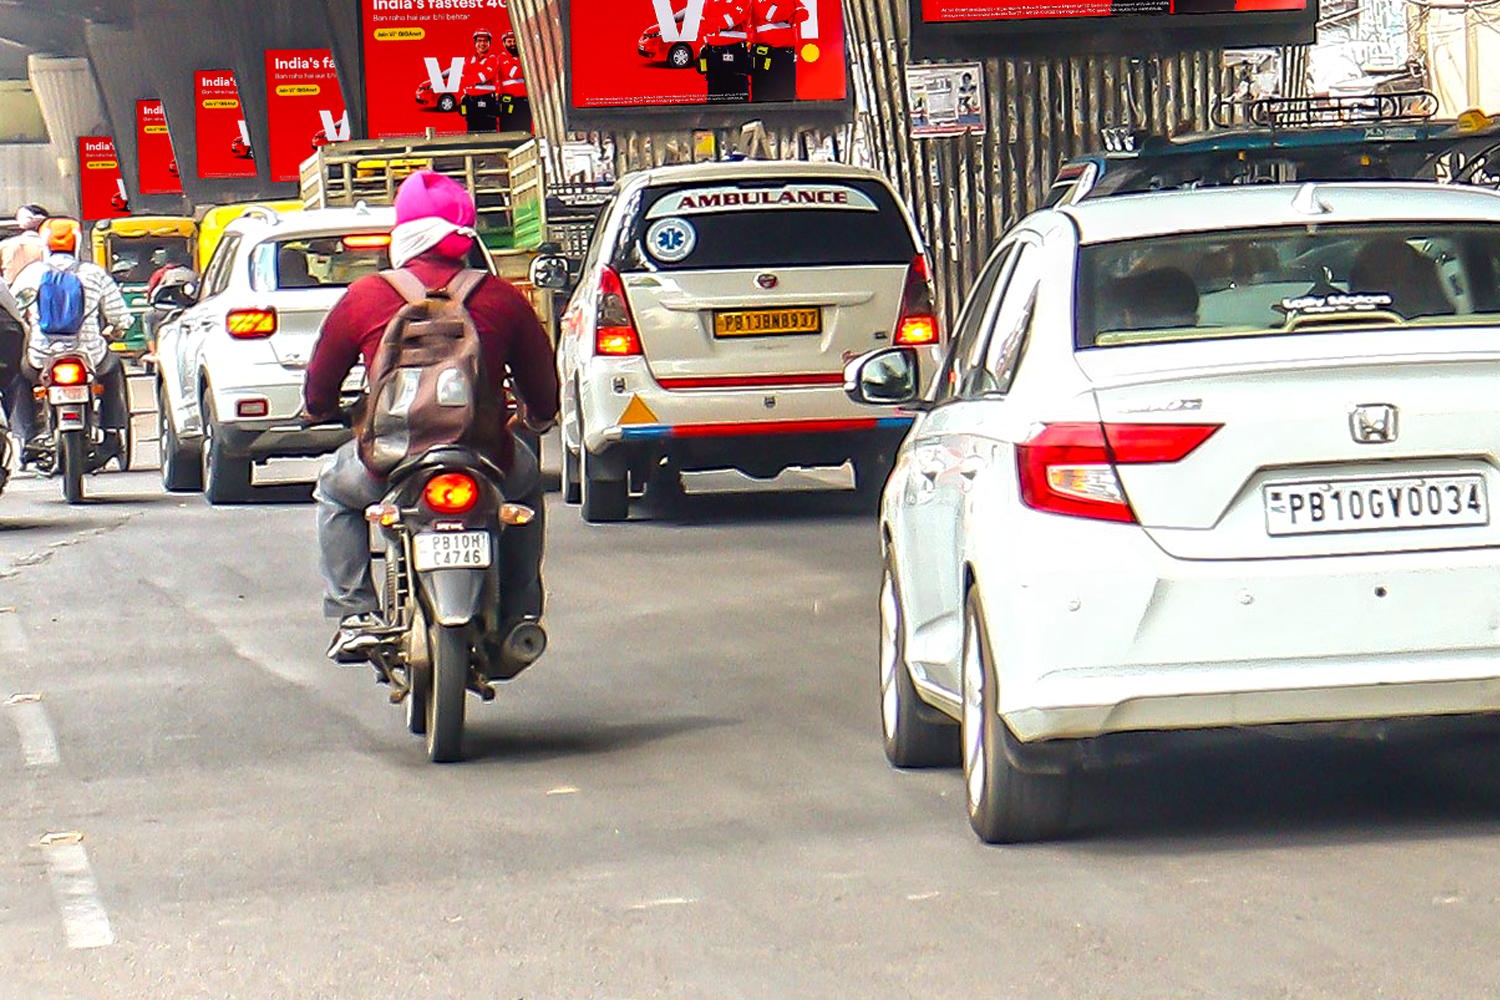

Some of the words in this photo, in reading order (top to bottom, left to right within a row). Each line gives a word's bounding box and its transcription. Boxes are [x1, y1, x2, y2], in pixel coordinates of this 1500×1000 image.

[275, 57, 320, 70] India's
[677, 190, 848, 209] AMBULANCE
[433, 550, 481, 566] C4746
